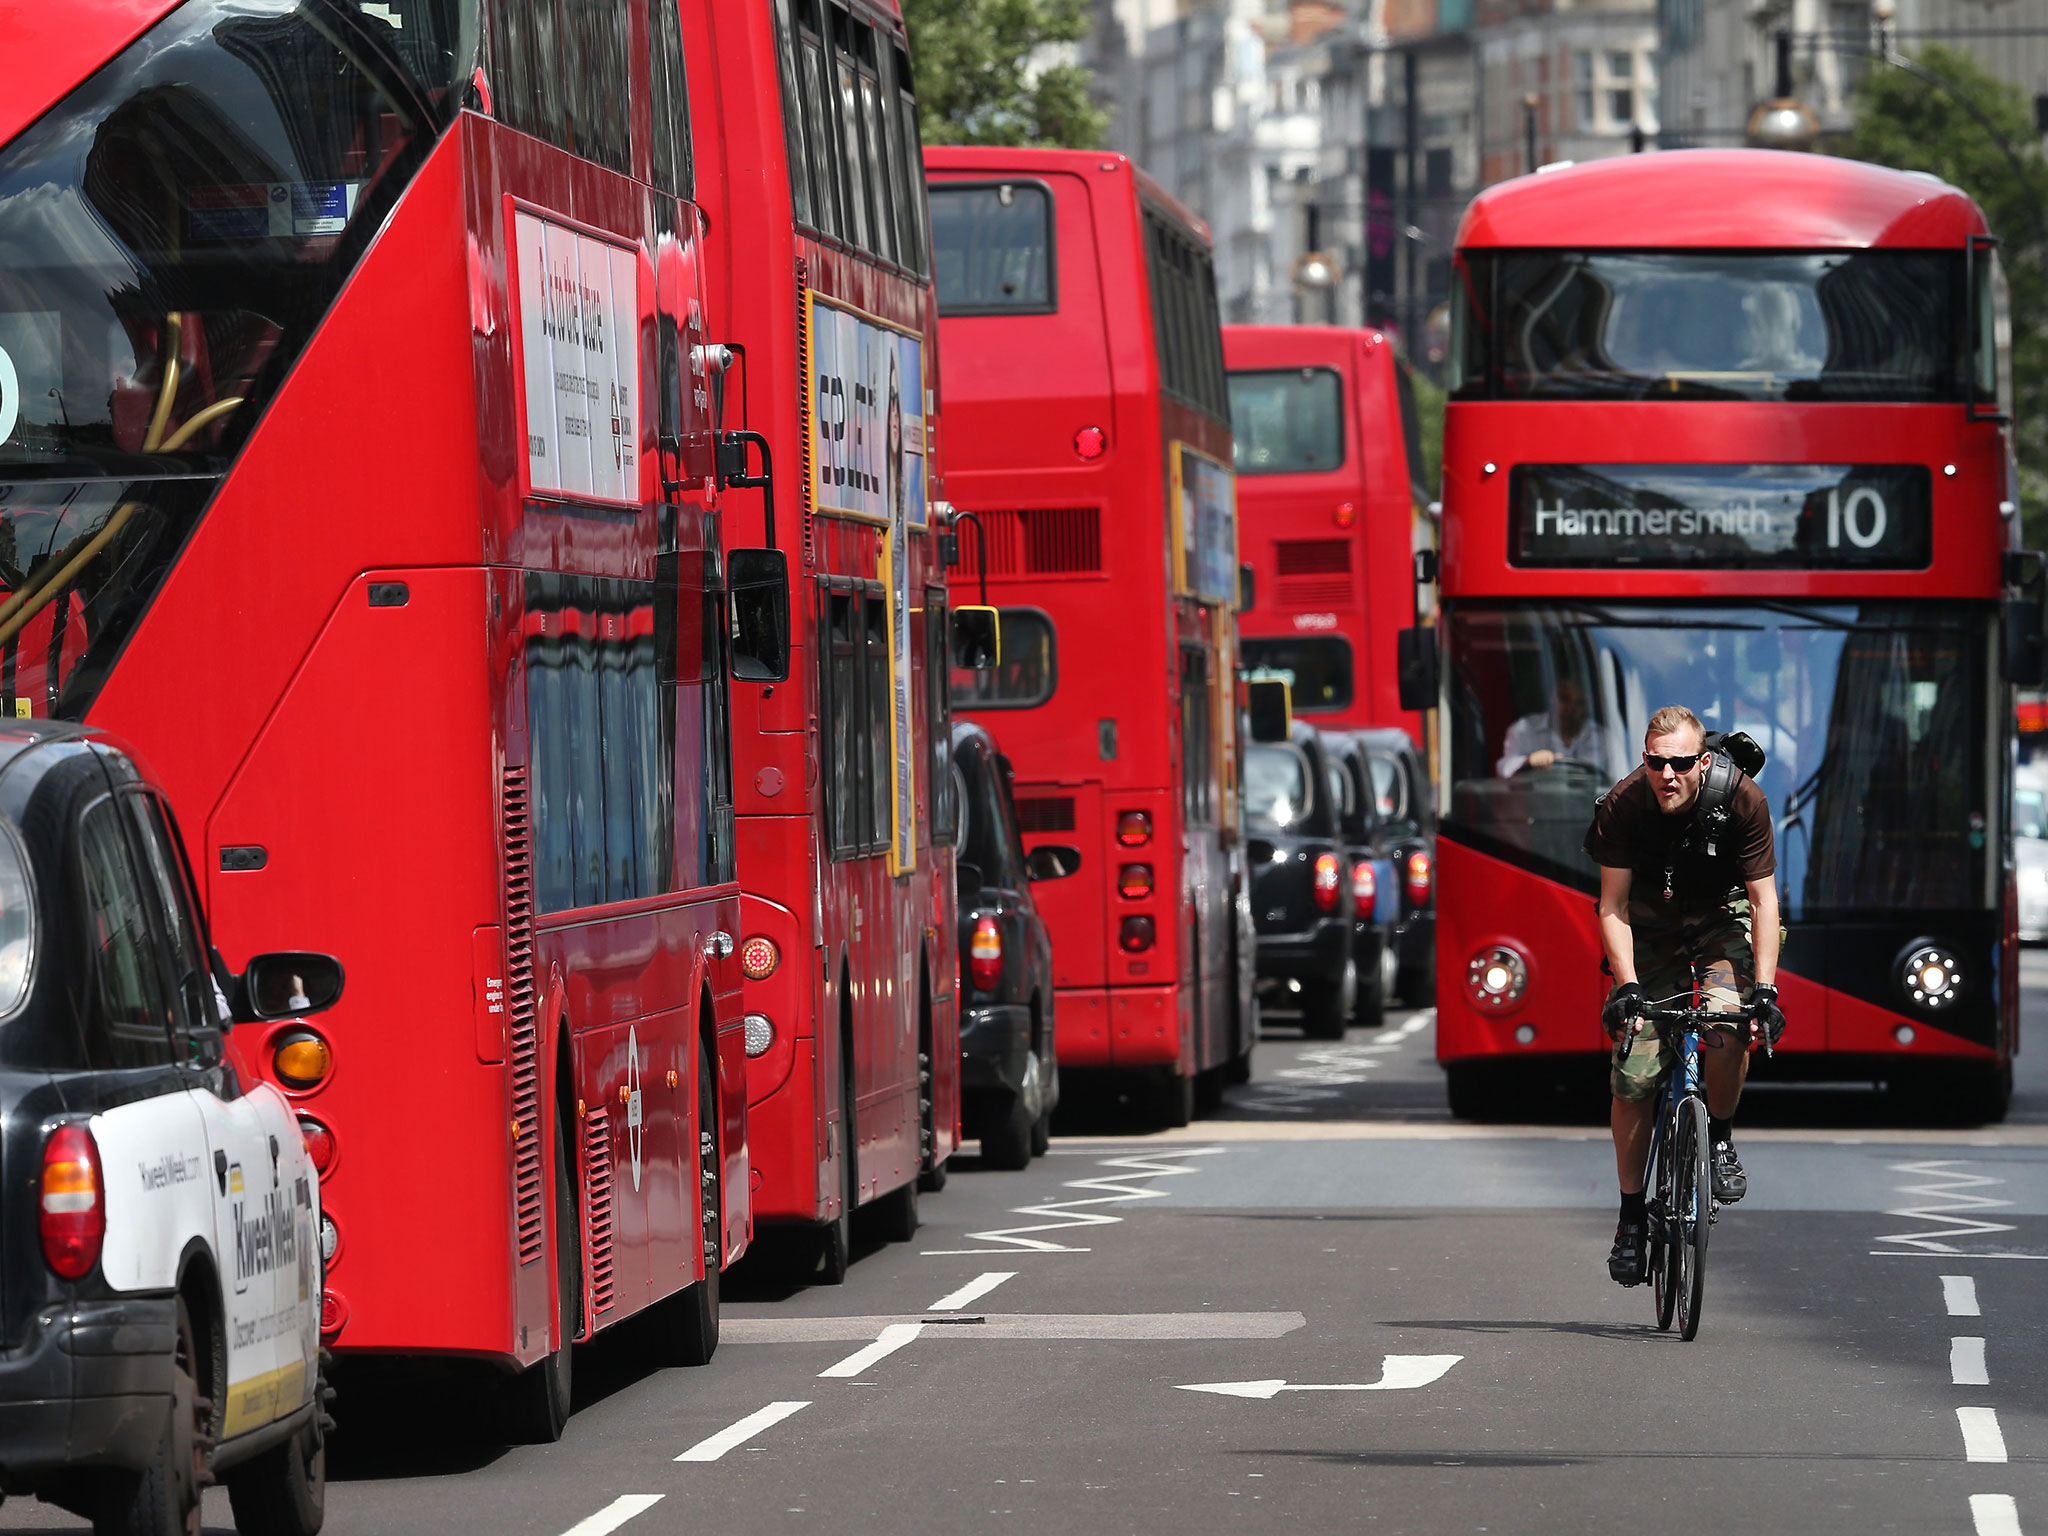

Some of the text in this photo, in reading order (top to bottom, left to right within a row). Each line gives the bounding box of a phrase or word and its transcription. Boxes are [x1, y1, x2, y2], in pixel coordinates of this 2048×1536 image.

[1536, 486, 1888, 550] Hammersmith 10
[234, 1187, 297, 1281] KweekWeek
